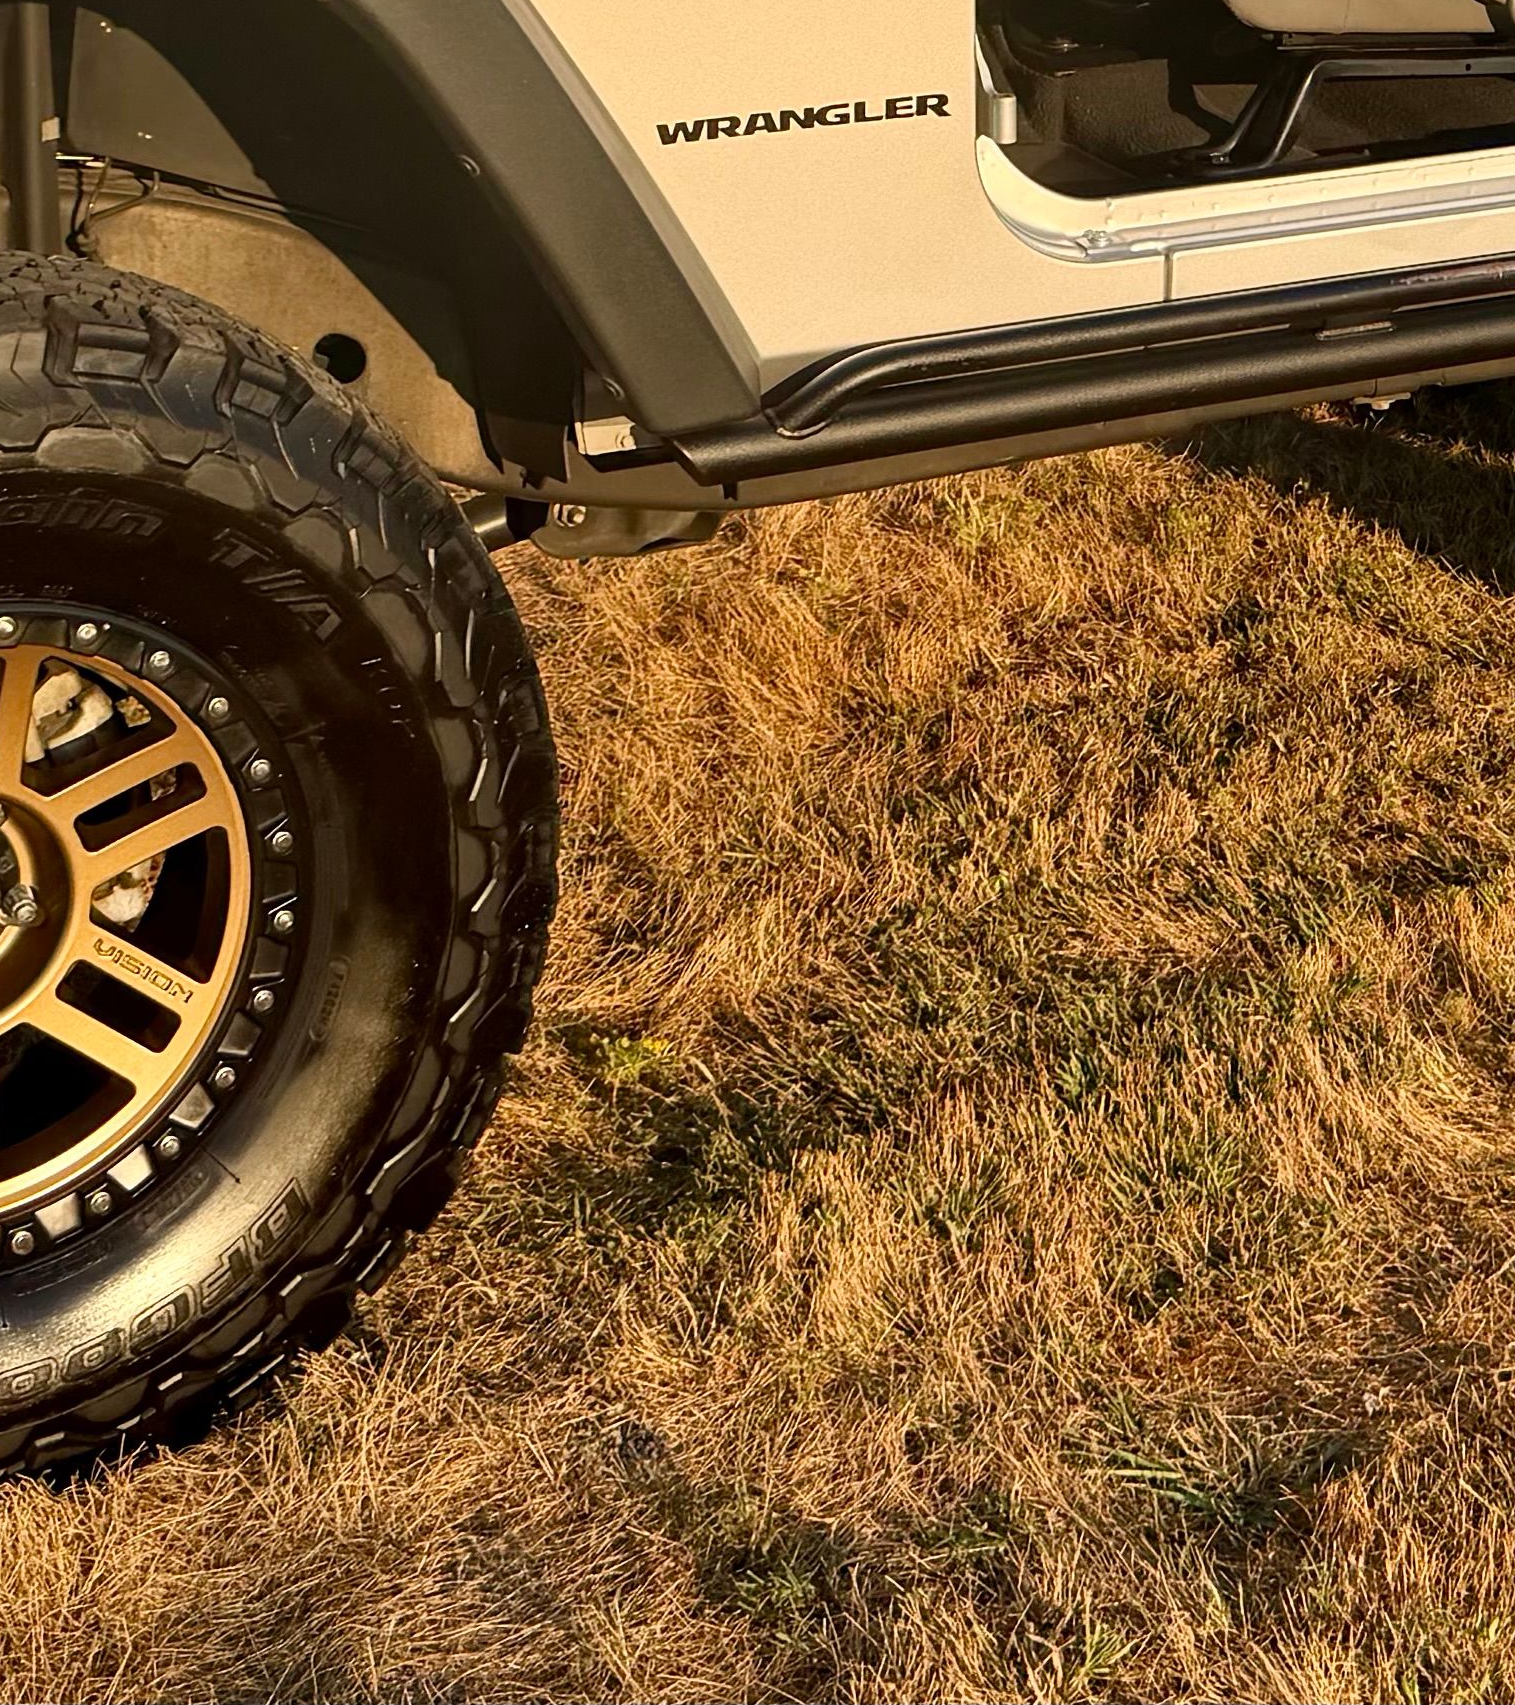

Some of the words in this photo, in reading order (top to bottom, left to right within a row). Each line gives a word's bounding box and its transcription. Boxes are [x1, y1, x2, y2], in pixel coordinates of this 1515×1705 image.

[656, 93, 952, 146] WRANGLER
[208, 525, 347, 643] T/A
[92, 937, 194, 1003] VISION
